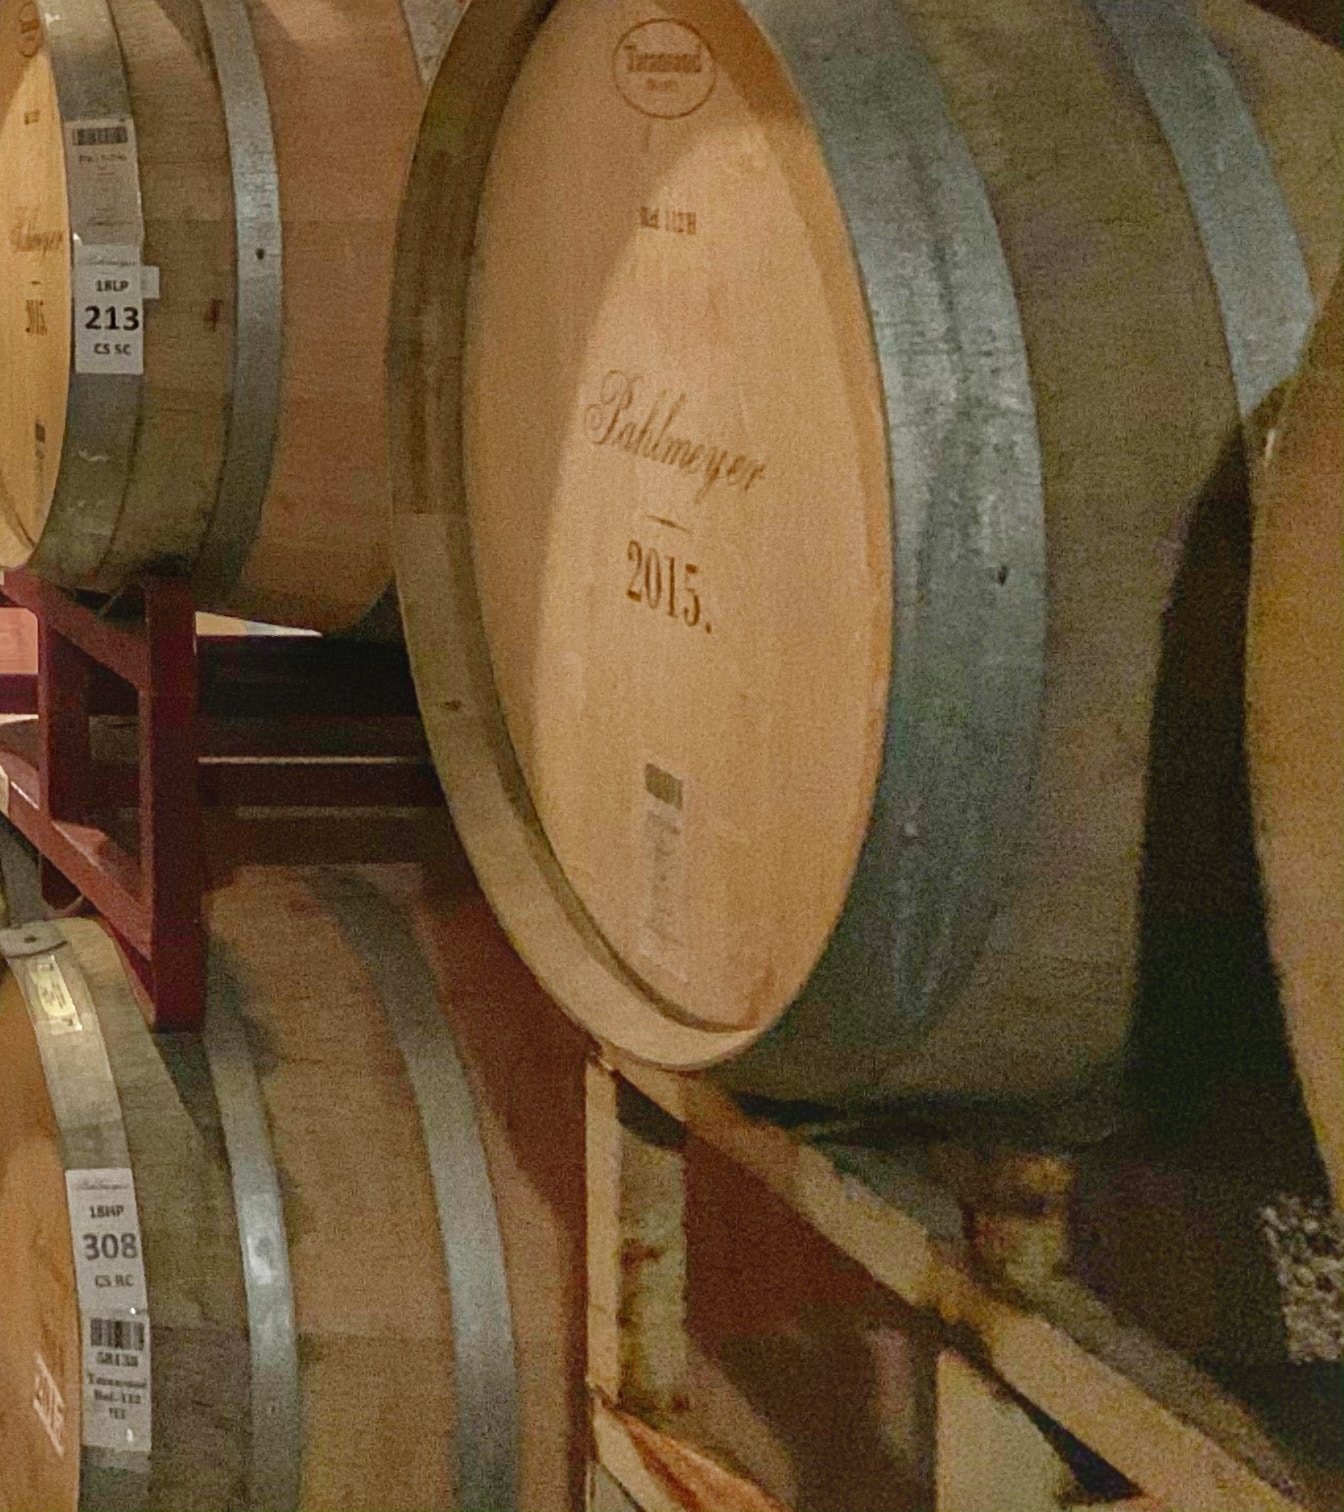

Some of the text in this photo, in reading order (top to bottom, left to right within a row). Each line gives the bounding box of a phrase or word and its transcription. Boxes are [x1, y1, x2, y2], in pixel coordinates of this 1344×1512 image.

[84, 305, 140, 331] 213
[93, 343, 111, 356] CS
[583, 370, 766, 505] Pahlmeyer
[627, 540, 713, 634] 2015.
[82, 1232, 139, 1261] 308
